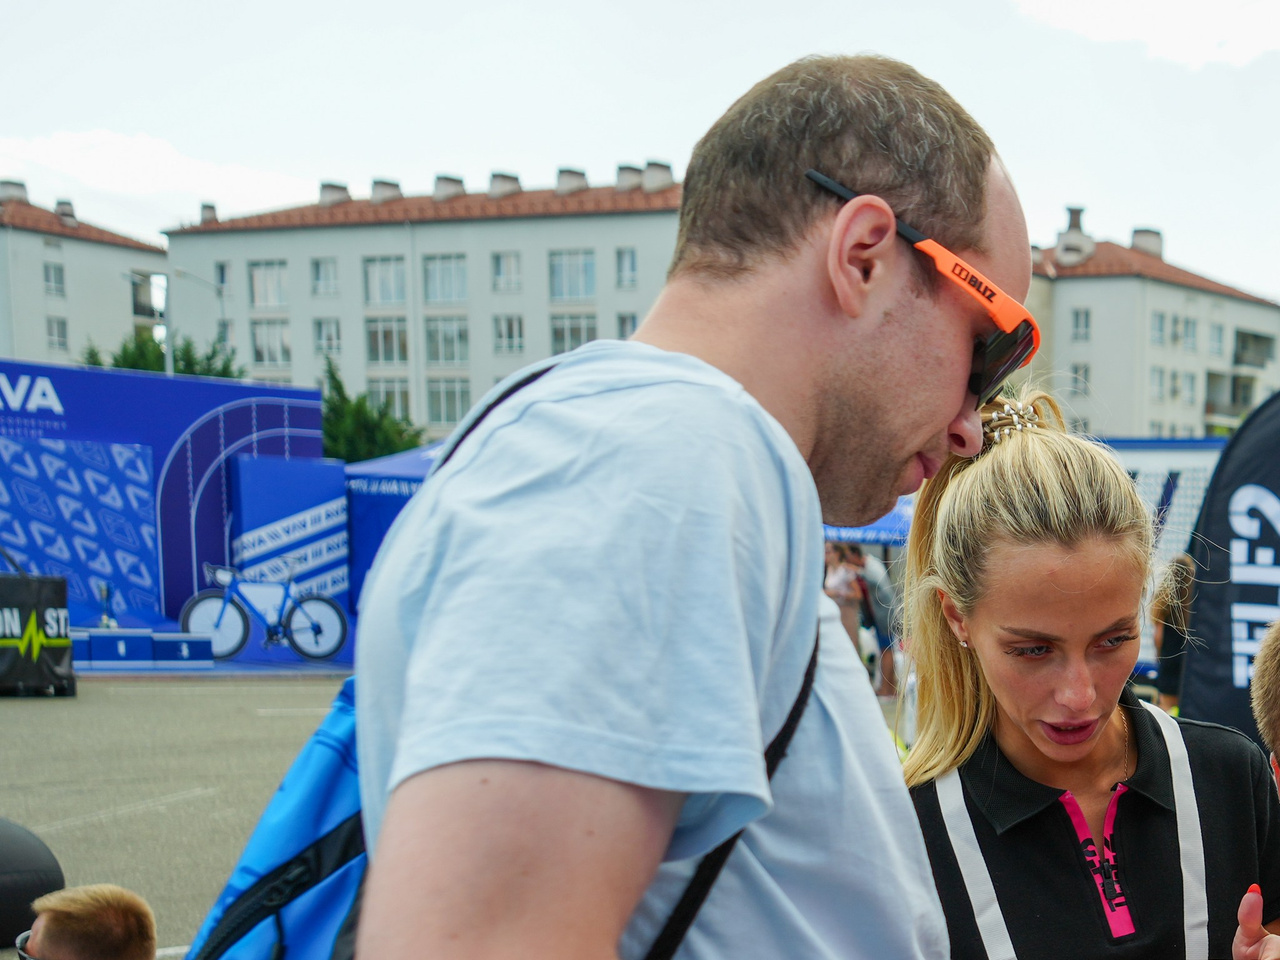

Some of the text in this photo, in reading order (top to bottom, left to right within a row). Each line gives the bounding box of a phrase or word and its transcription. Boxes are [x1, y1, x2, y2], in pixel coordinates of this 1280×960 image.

[968, 275, 997, 303] BLIZ
[0, 372, 65, 416] VA
[44, 607, 70, 638] ST
